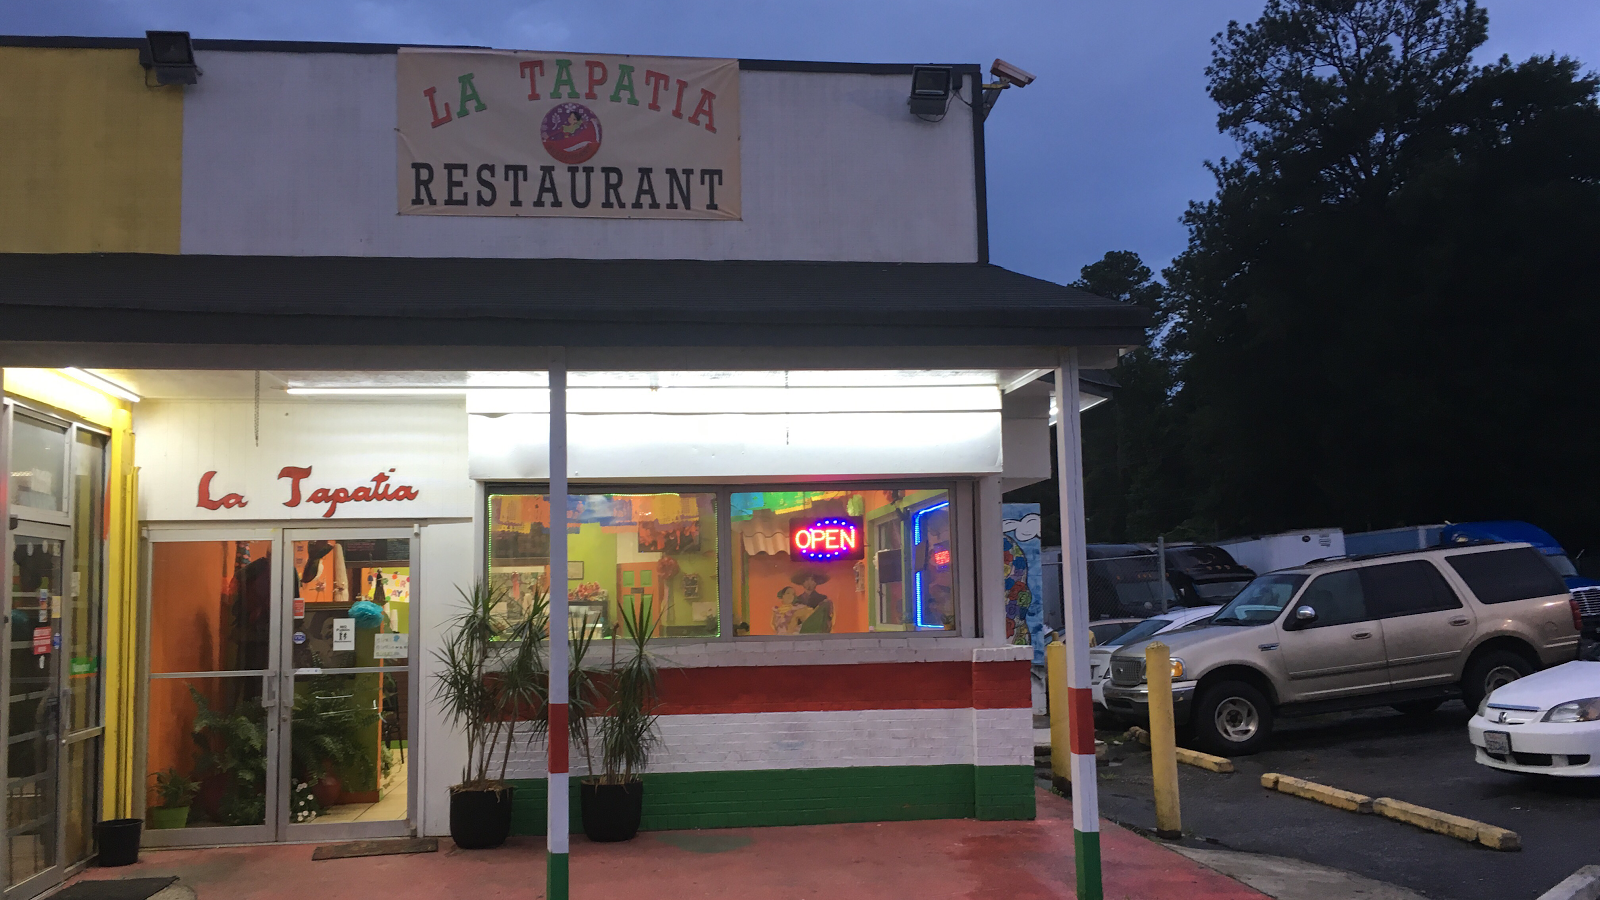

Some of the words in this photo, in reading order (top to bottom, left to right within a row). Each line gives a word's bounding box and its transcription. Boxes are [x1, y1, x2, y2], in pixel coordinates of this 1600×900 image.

[423, 73, 487, 128] LA
[519, 59, 717, 133] TAPATIA
[411, 162, 723, 210] RESTAURANT
[196, 470, 249, 510] La
[795, 529, 855, 549] OPEN
